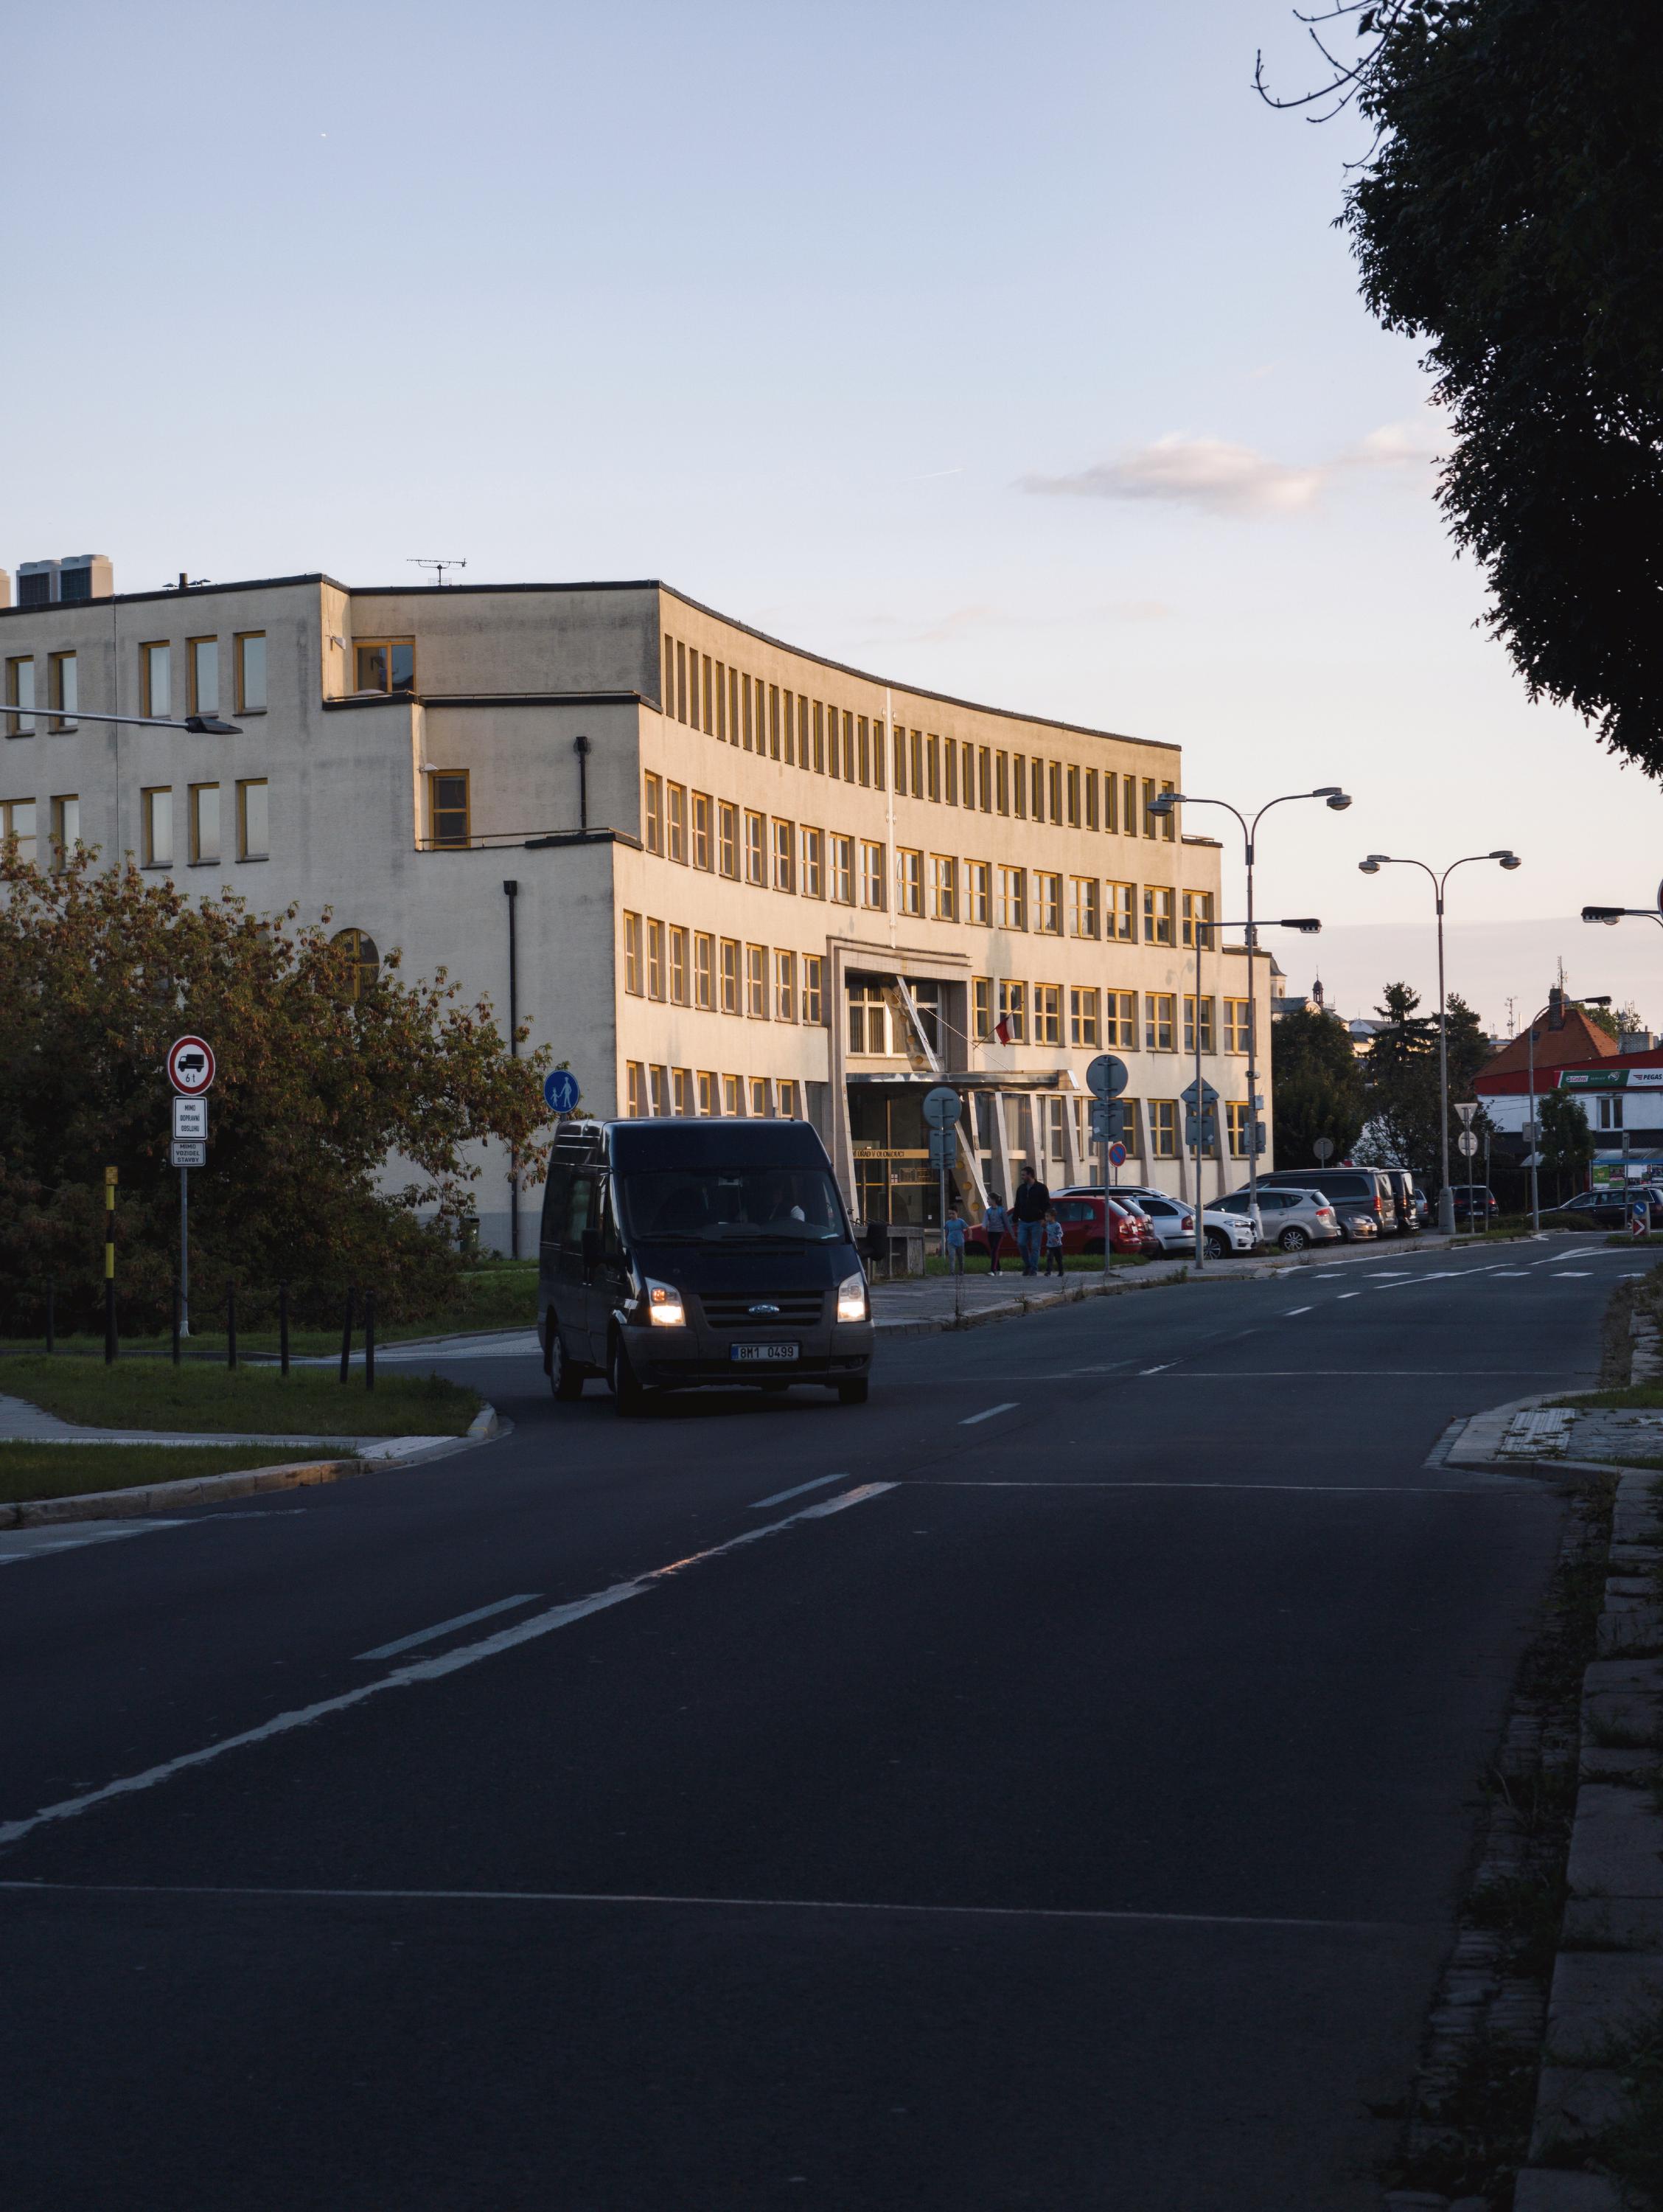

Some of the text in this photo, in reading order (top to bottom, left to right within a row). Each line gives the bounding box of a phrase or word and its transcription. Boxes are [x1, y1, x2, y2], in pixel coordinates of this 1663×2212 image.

[185, 1074, 190, 1082] 6
[740, 1346, 794, 1358] 8M1 0499
